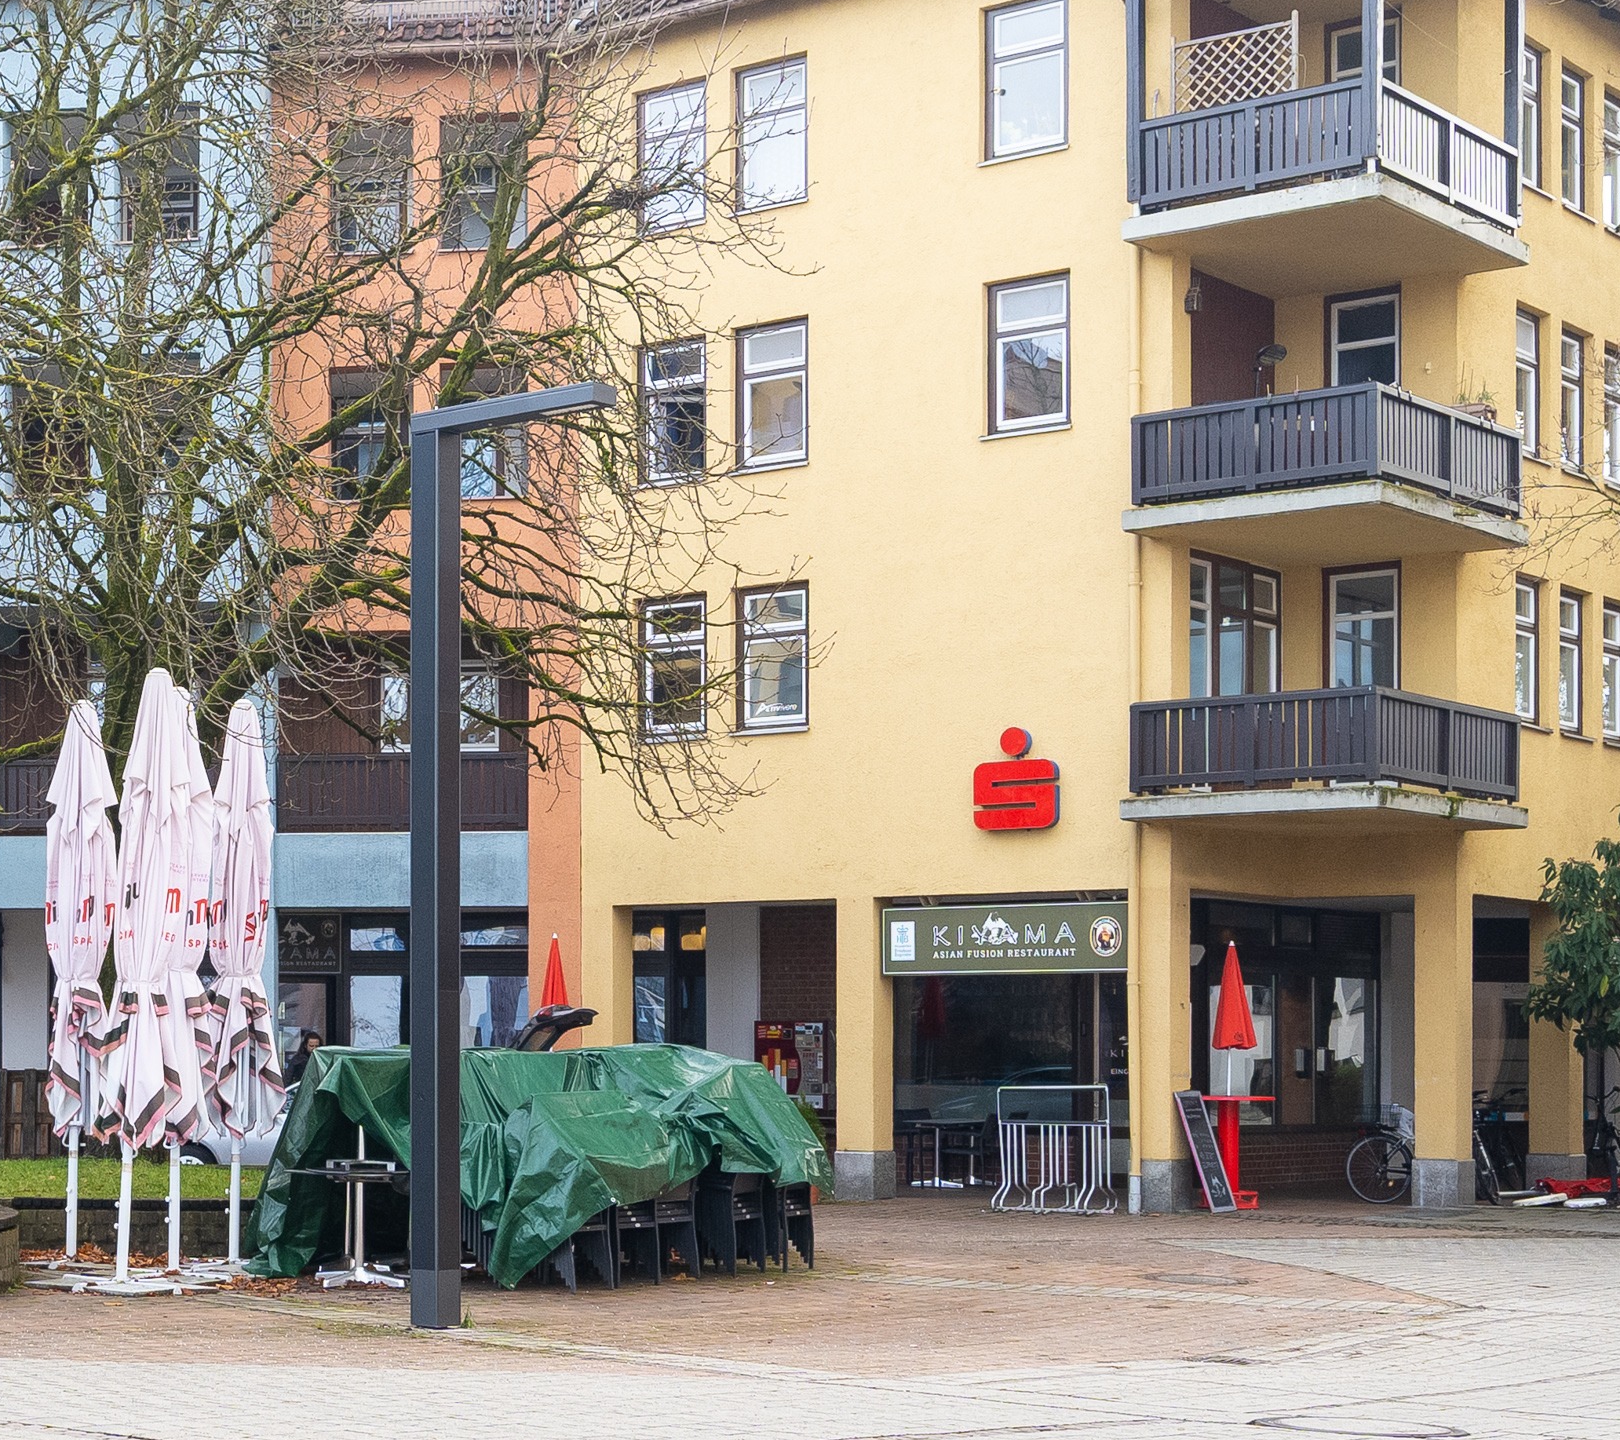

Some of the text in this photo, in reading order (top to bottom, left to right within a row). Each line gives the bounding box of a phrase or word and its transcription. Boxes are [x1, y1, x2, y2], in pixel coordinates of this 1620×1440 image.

[932, 921, 1076, 947] KIYAMA
[279, 946, 336, 960] YAMA
[933, 948, 1076, 959] ASIAN FUSION RESTAURANT
